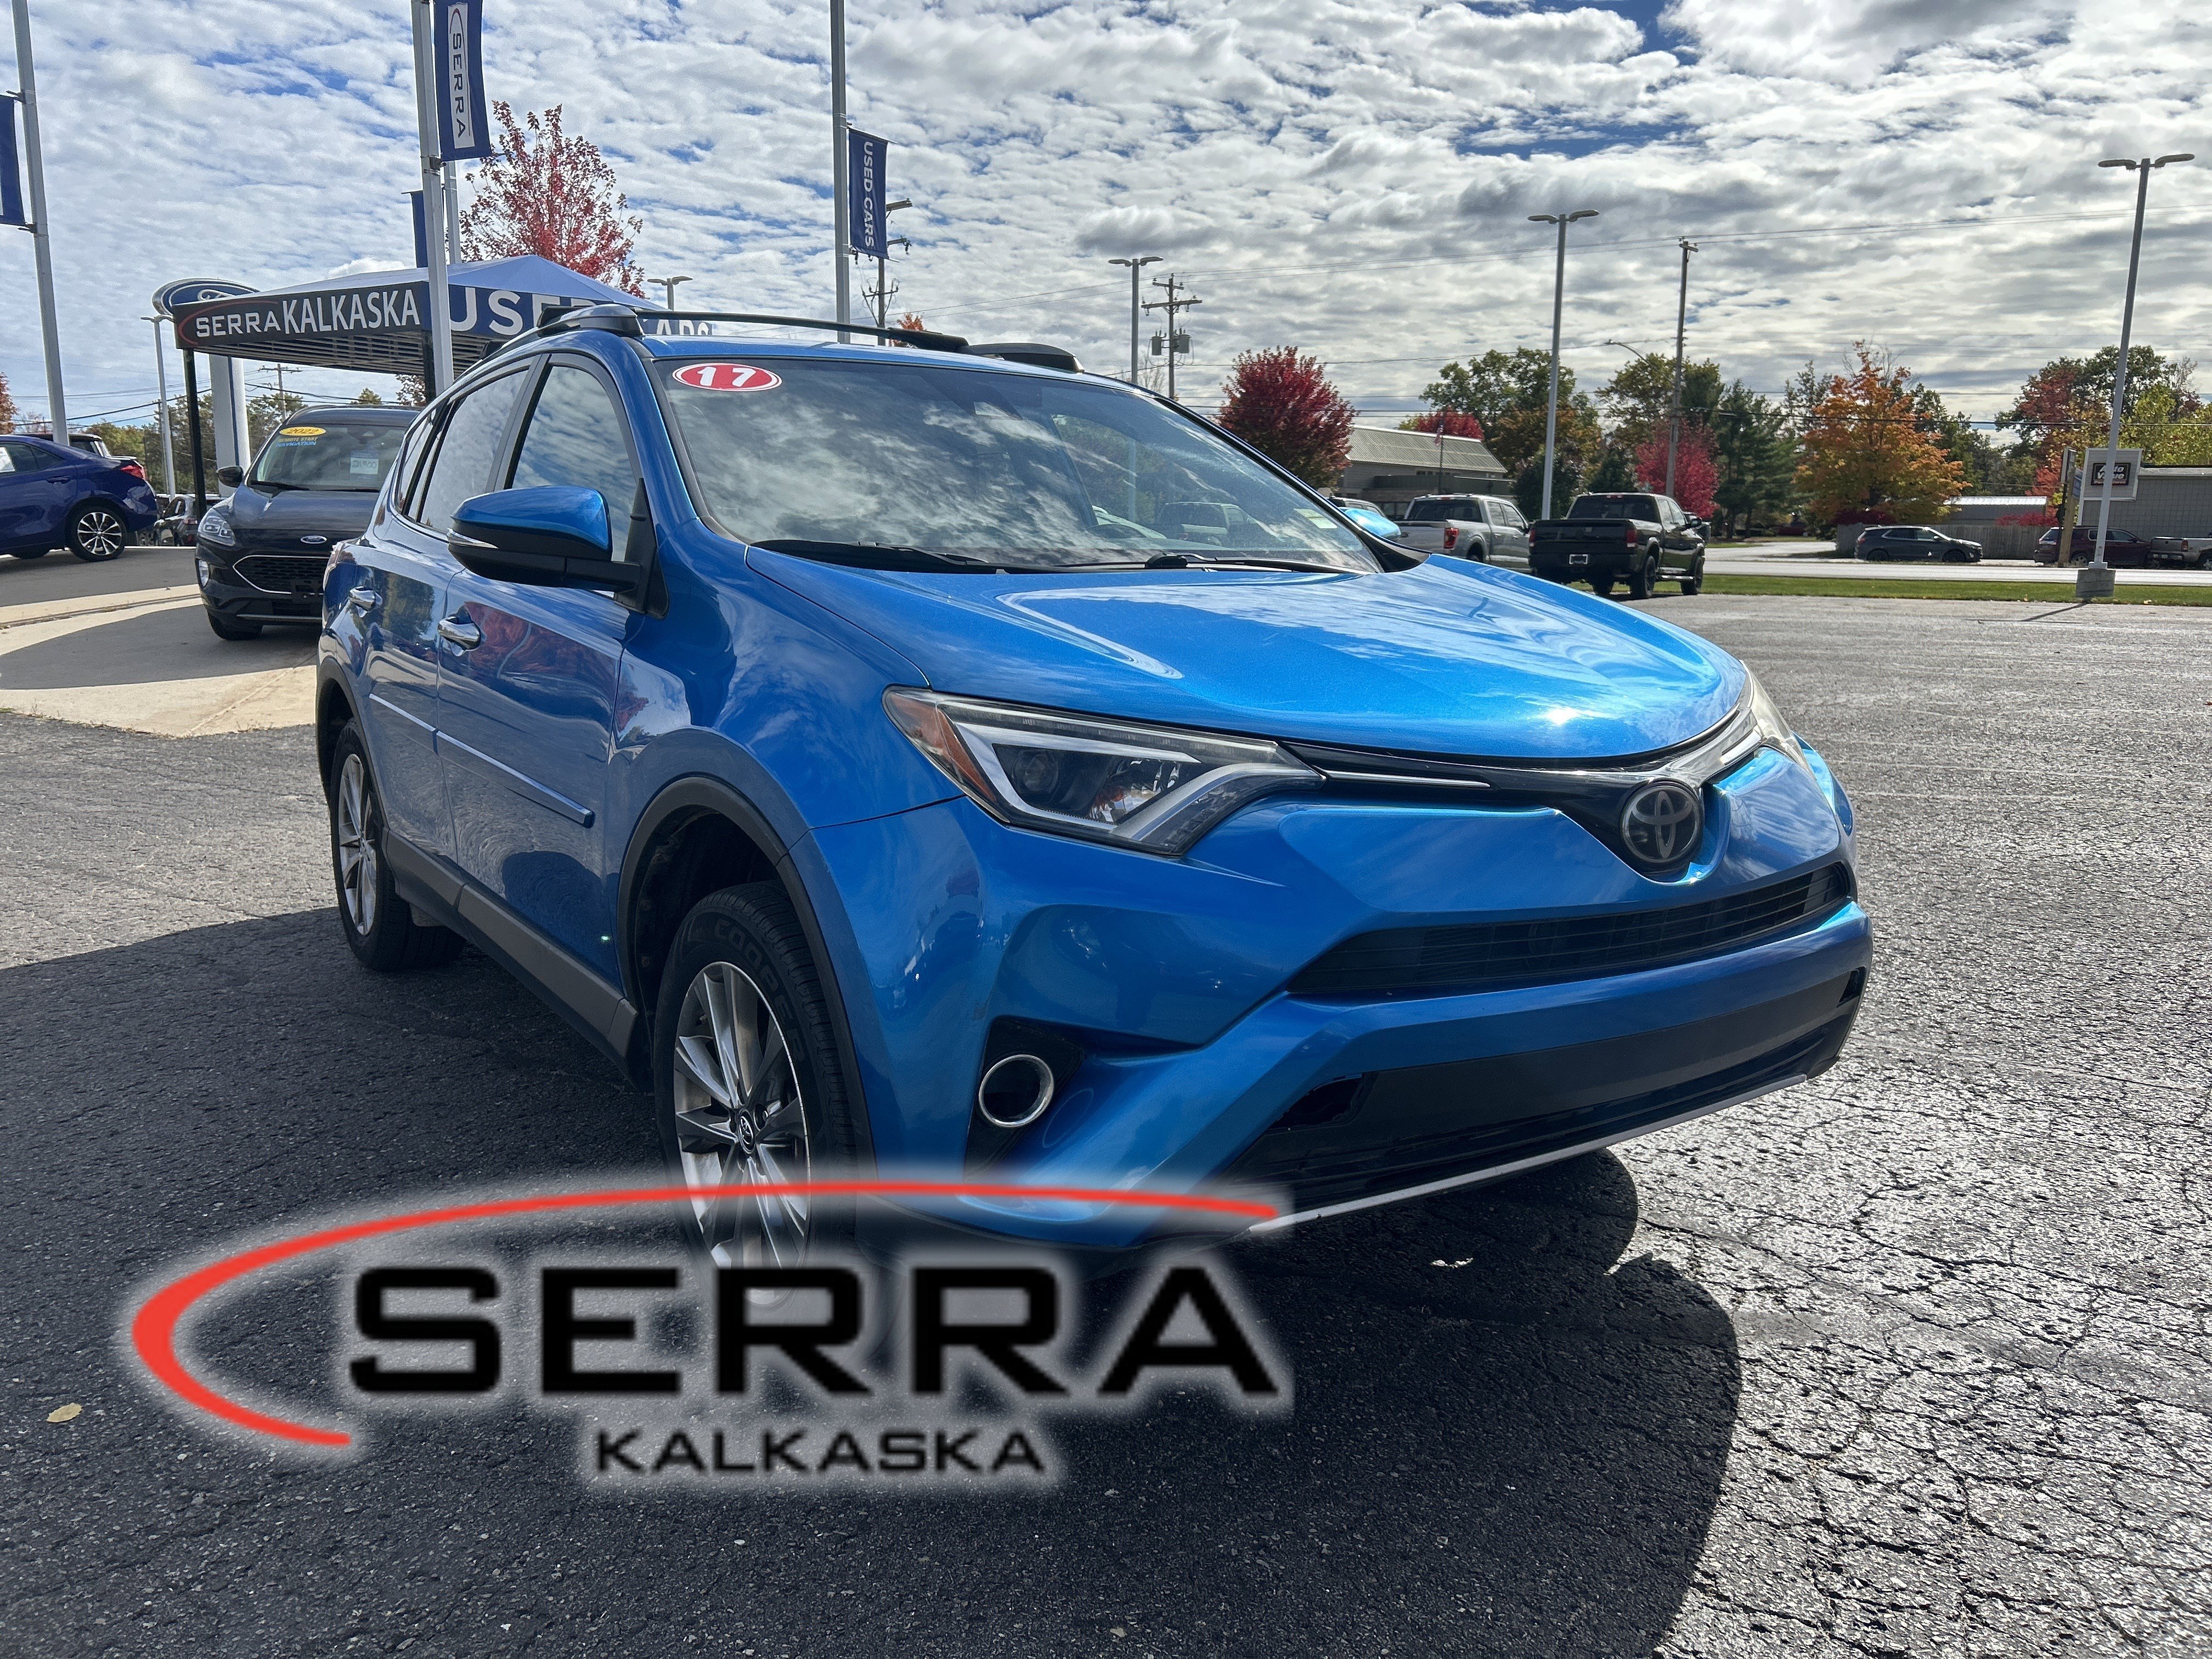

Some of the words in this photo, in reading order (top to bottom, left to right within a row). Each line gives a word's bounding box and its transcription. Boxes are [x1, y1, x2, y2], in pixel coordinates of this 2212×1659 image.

[453, 33, 466, 138] SERRA
[864, 141, 873, 192] USED
[864, 197, 874, 249] CARS
[196, 311, 280, 337] SERRA
[283, 289, 421, 334] KALKASKA
[449, 287, 596, 336] USE
[697, 366, 757, 387] 17
[714, 918, 805, 1061] COOPER
